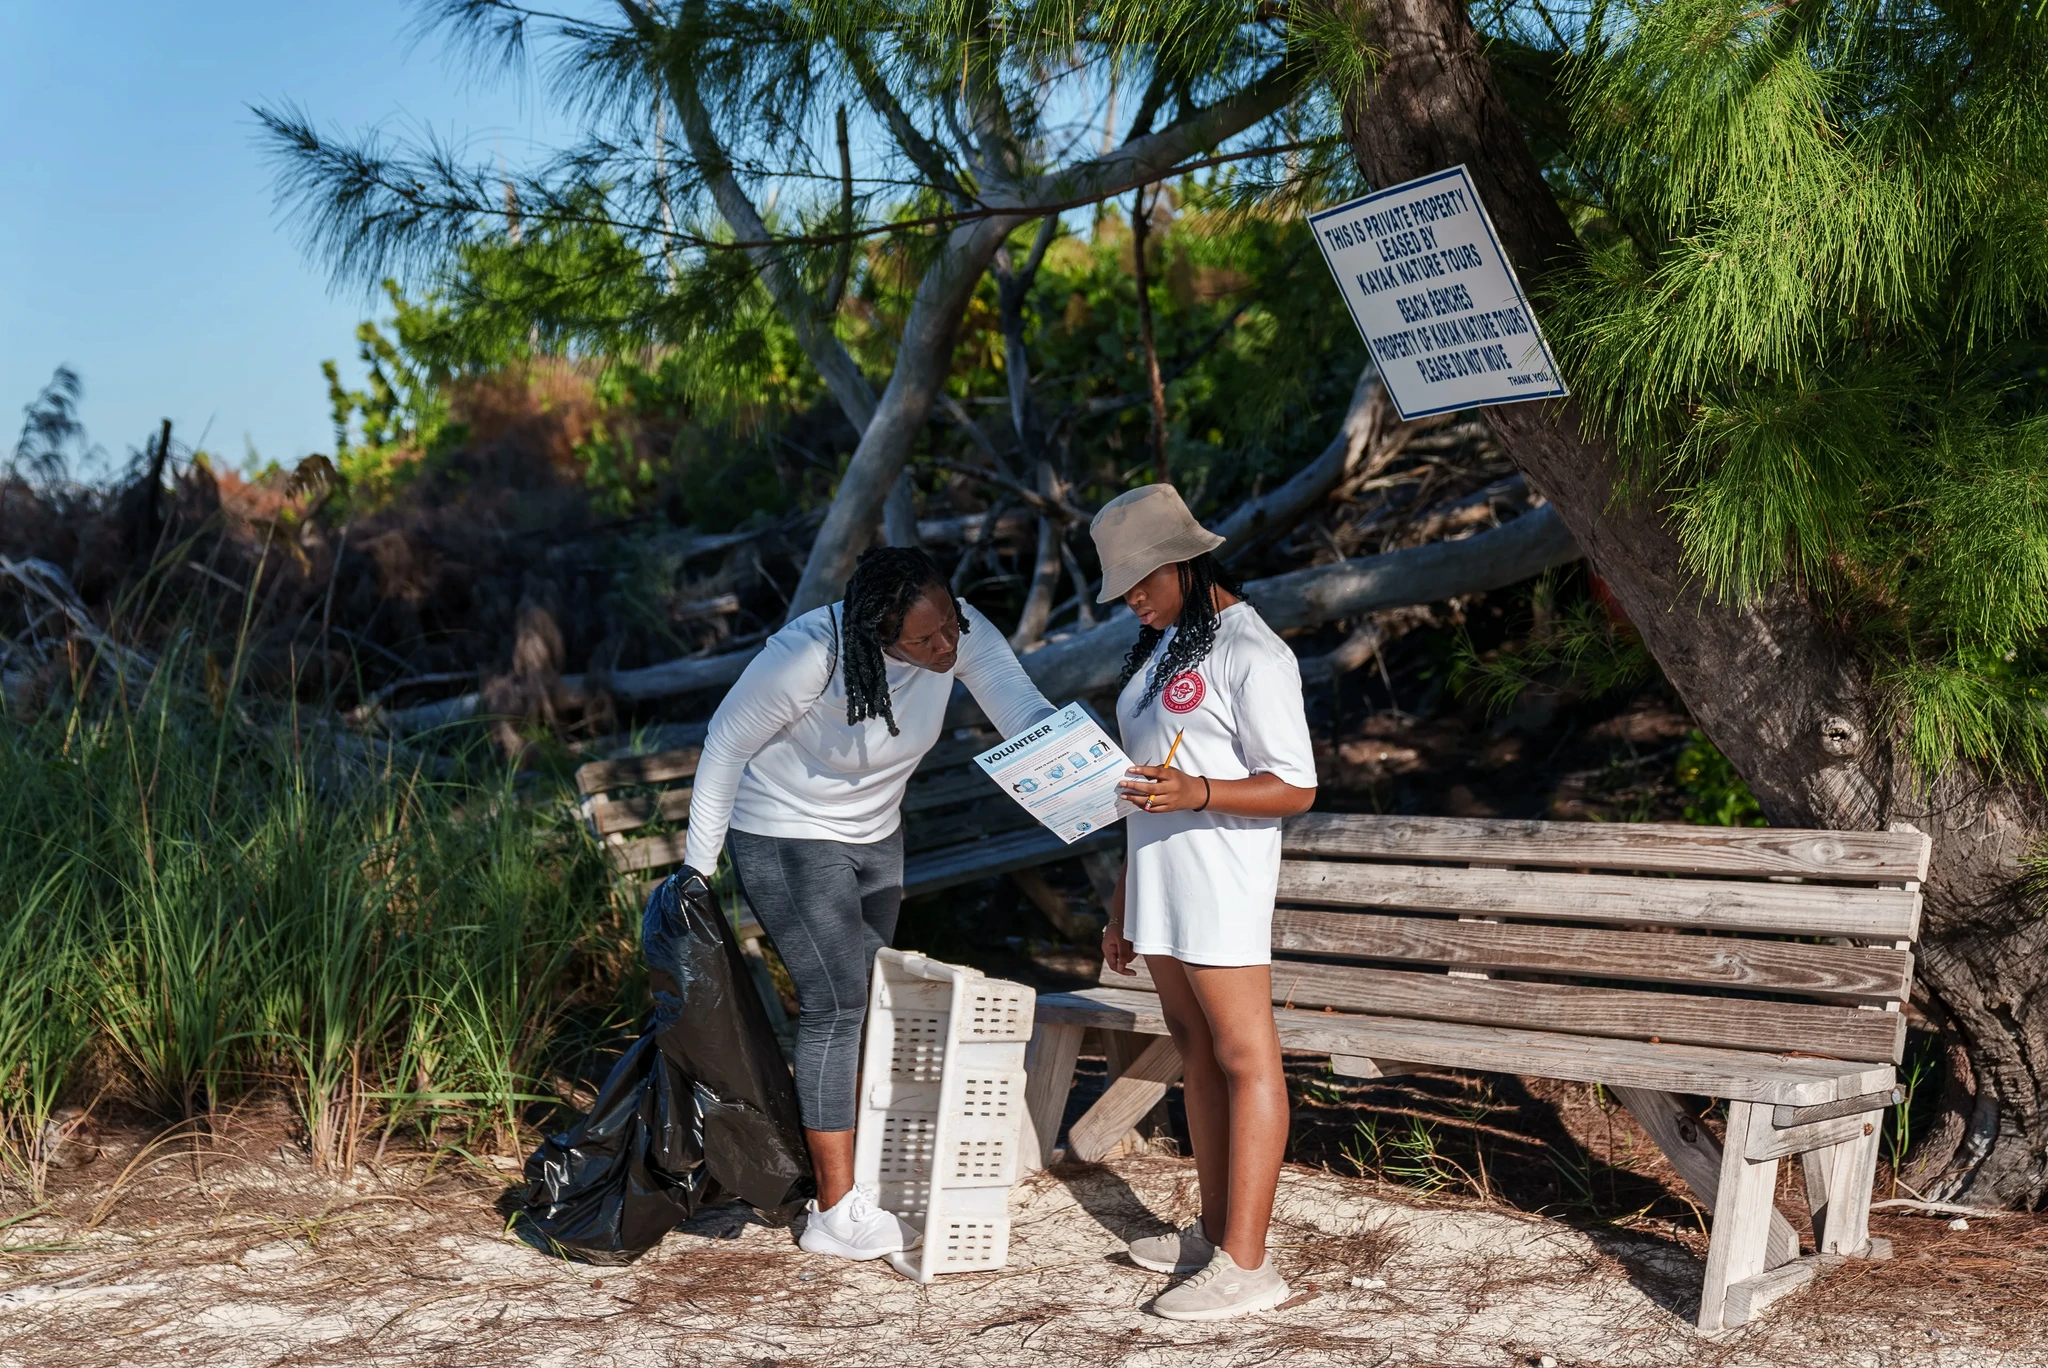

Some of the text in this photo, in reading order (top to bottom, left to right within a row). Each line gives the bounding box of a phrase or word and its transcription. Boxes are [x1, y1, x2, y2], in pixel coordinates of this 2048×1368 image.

[1324, 189, 1469, 251] THIS IS PRIVATE PROPERTY
[1376, 226, 1438, 262] LEASED BY
[1356, 243, 1482, 296] KAYAK NATURE TOURS
[1396, 284, 1474, 323] BEACH BENCHES
[1372, 307, 1528, 362] PROPERTY OF KAYAK NATURE TOURS
[1416, 344, 1512, 383] PLEASE DO NOT MOVE
[1507, 374, 1534, 386] THANK
[984, 725, 1053, 764] VOLUNTEER
